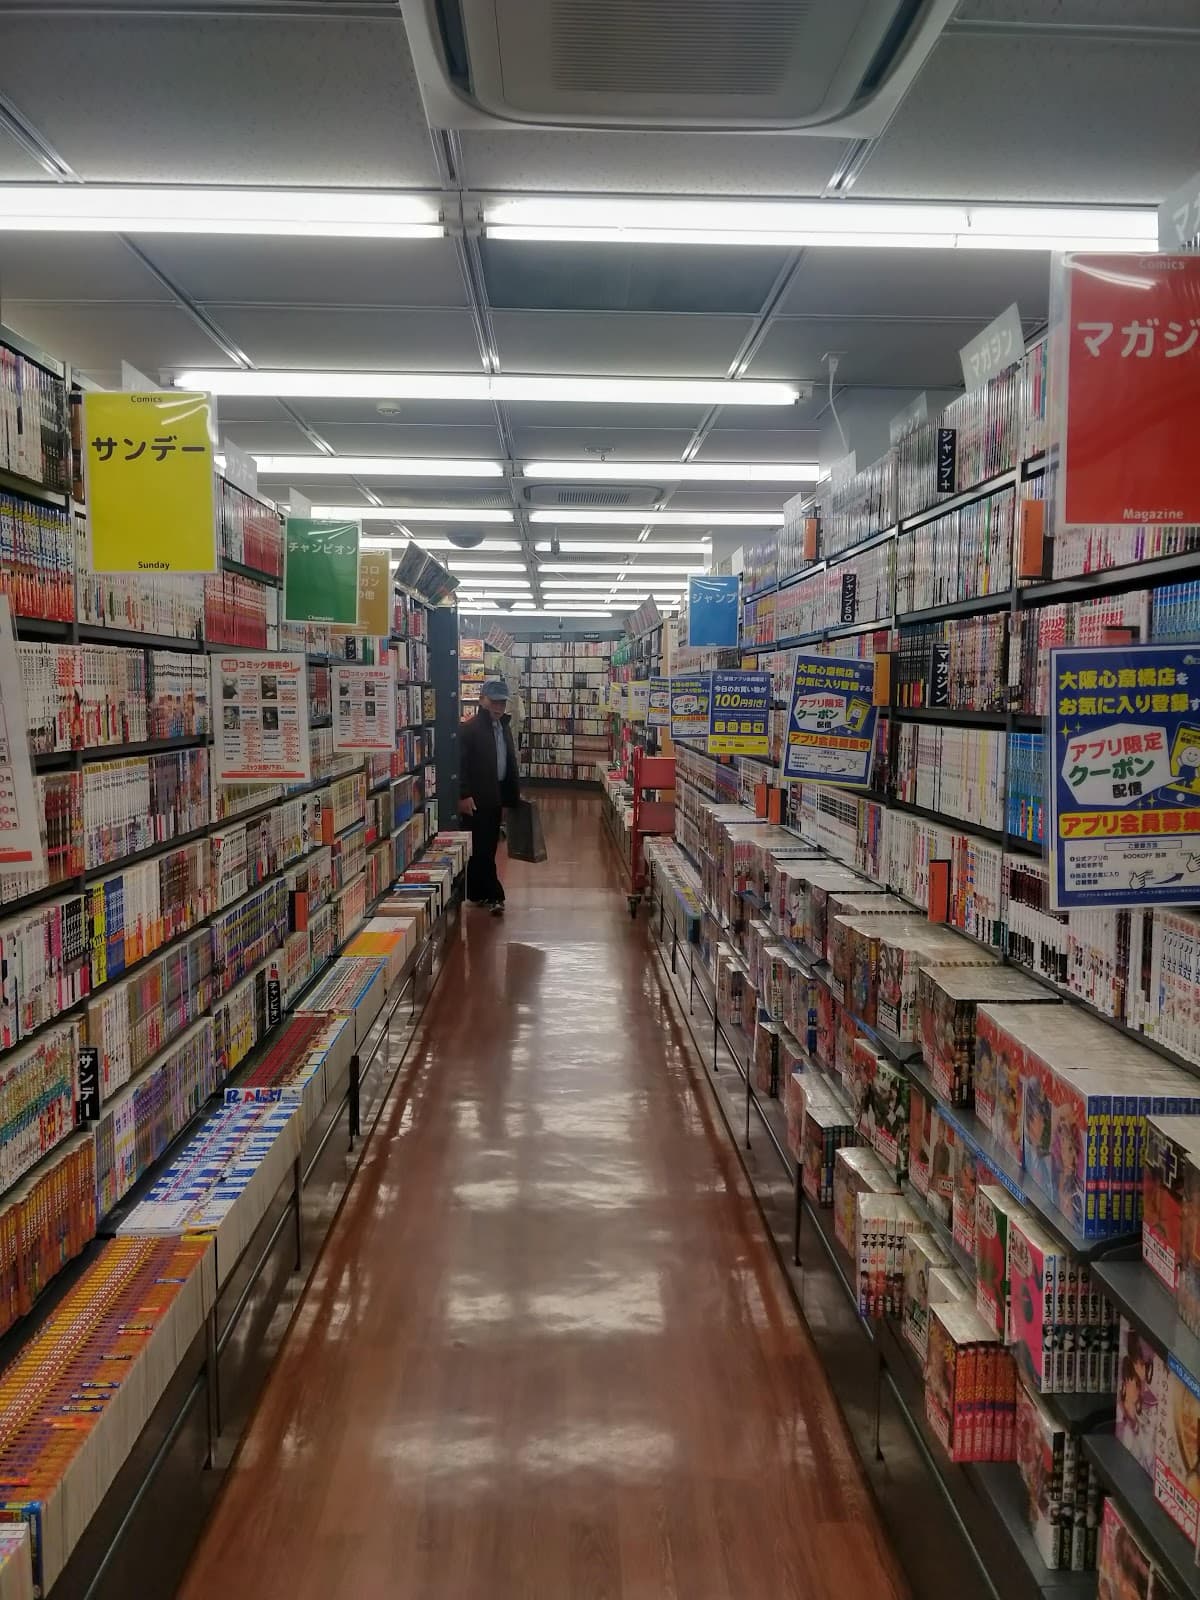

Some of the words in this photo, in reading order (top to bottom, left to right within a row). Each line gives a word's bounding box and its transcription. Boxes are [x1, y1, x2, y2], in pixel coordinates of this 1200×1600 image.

[130, 394, 163, 404] Comics
[91, 434, 206, 462] サンデー
[1123, 508, 1184, 521] Magazine
[288, 542, 356, 555] チャンピオン
[137, 560, 171, 572] Sunday
[692, 592, 737, 604] ジャンプ
[936, 650, 949, 704] マガジン
[1070, 732, 1164, 763] アプリ限定
[1069, 756, 1155, 787] クーポン
[1112, 782, 1143, 799] 配信
[80, 1055, 95, 1118] サンデー
[1088, 1115, 1097, 1168] MAJOR
[1100, 1115, 1109, 1168] MAJOR
[1113, 1115, 1124, 1168] MAJOR
